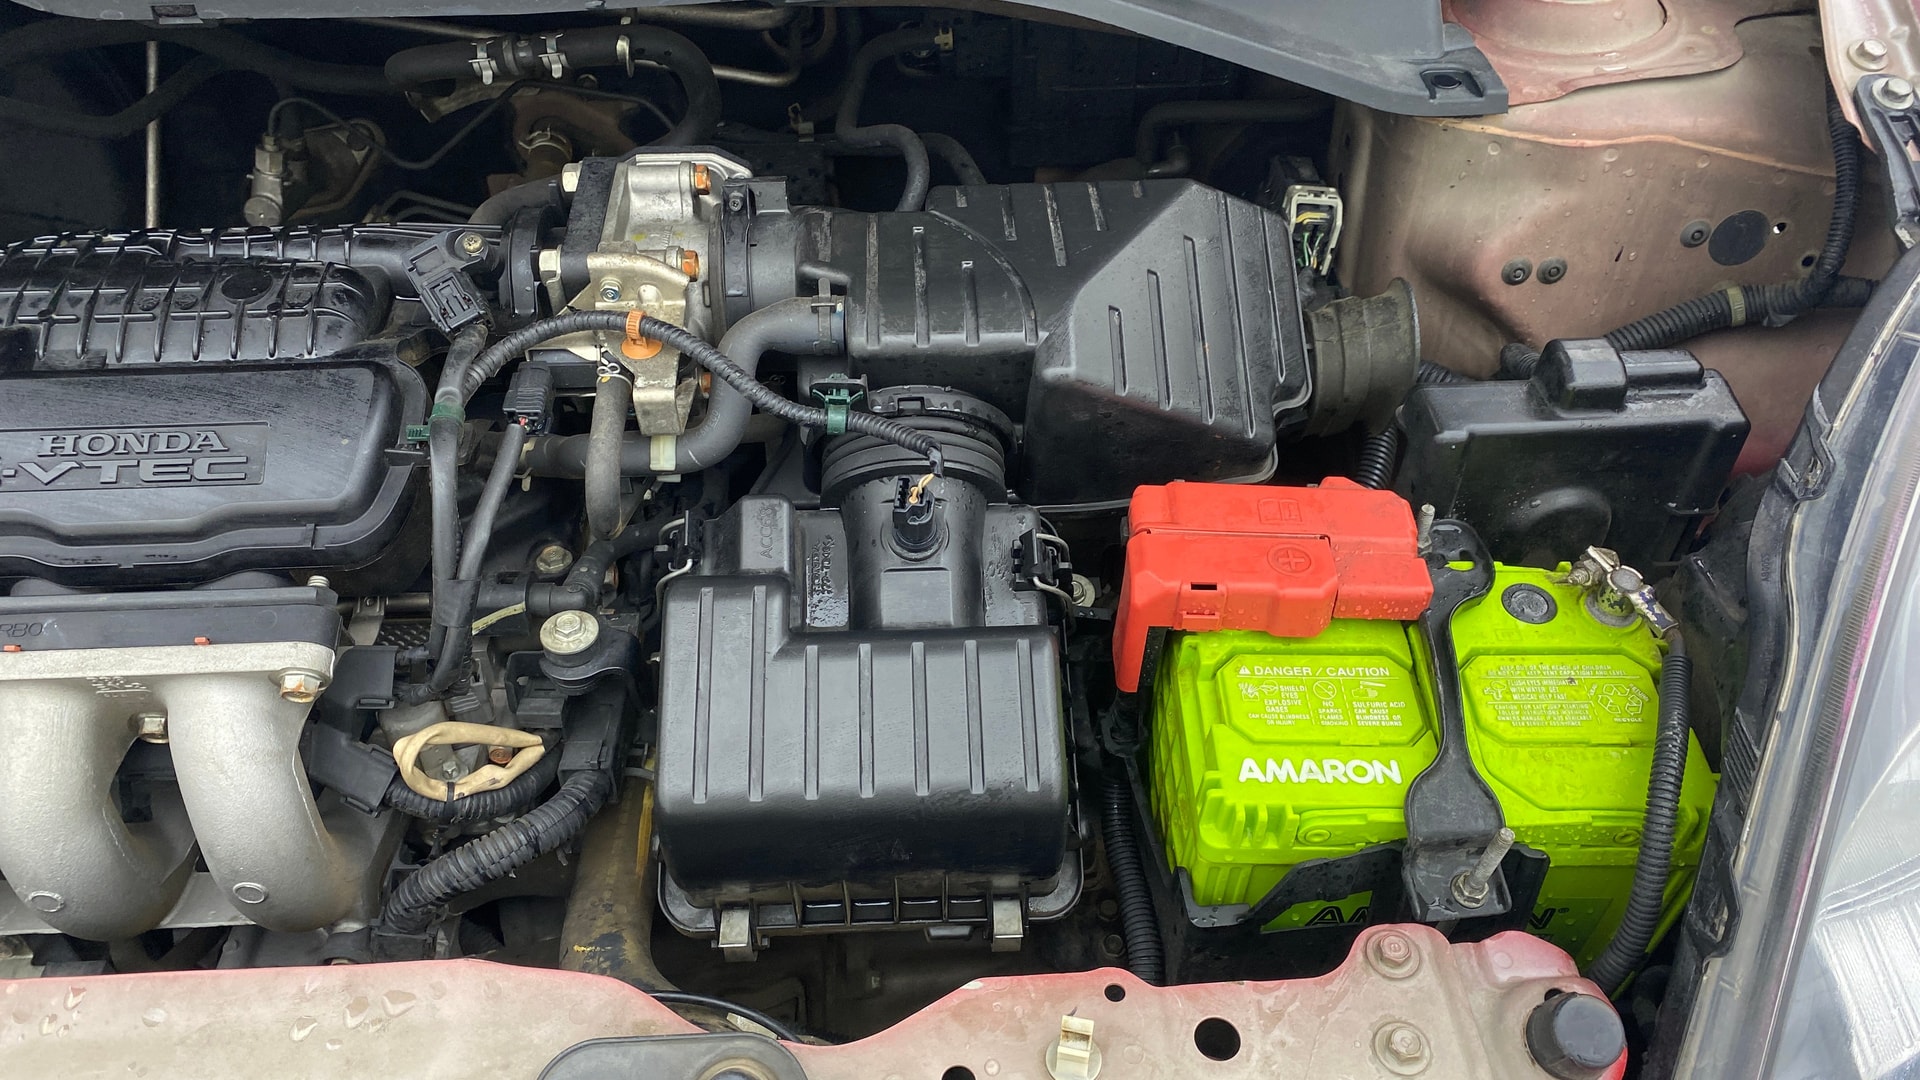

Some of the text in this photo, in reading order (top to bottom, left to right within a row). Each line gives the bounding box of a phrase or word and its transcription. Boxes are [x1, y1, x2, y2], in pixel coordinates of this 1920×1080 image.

[38, 430, 230, 457] HONDA
[1254, 665, 1312, 676] DANGER
[1326, 666, 1390, 677] CAUTION
[1238, 758, 1402, 784] AMARON
